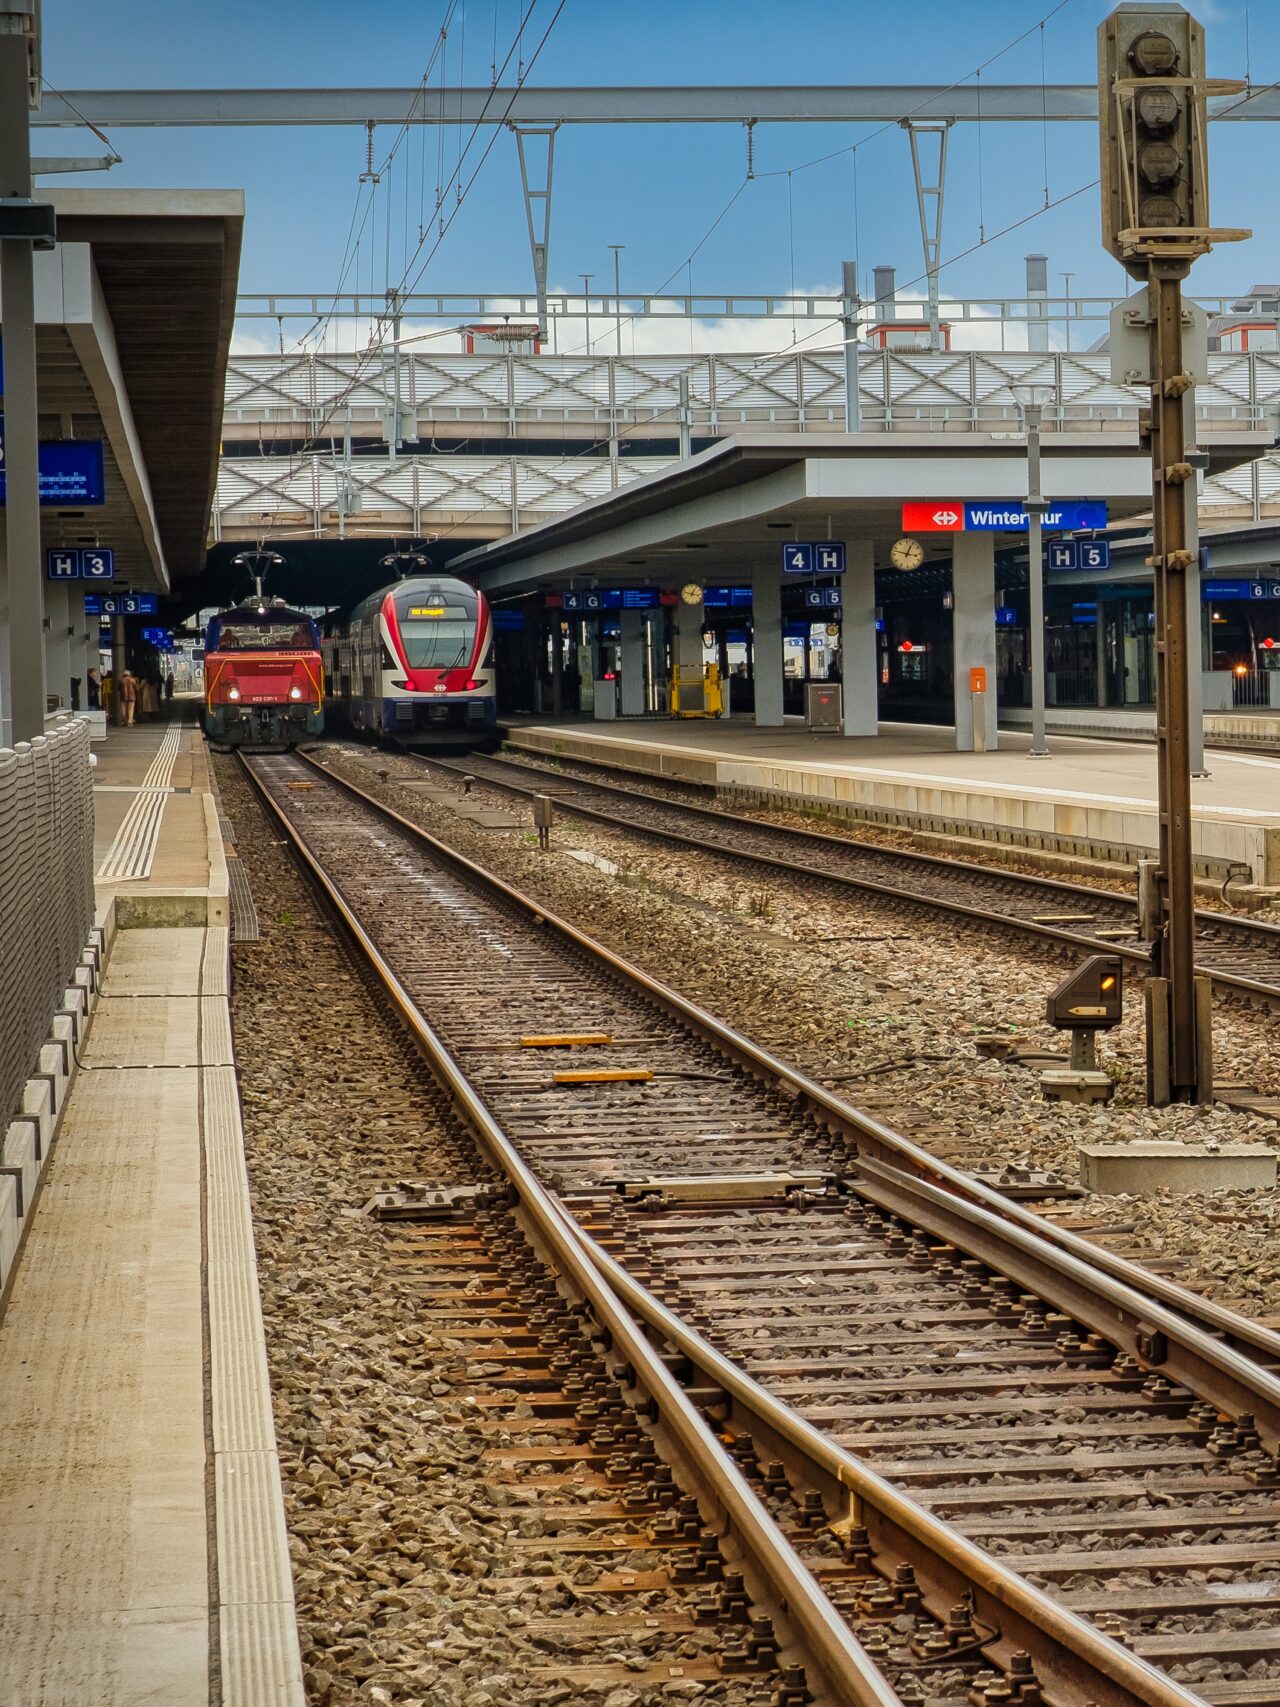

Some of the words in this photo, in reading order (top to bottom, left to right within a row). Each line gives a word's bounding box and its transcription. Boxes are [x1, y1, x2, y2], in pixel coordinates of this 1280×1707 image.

[970, 510, 1063, 526] Winterur
[791, 552, 805, 568] 4
[822, 552, 837, 568] H
[1056, 550, 1070, 566] H
[1088, 549, 1100, 566] 5
[56, 558, 72, 575] H
[91, 558, 104, 575] 3
[1254, 585, 1263, 596] 6
[568, 596, 577, 607] 4
[587, 596, 598, 607] G
[810, 593, 820, 604] G
[831, 593, 839, 603] 5
[104, 600, 115, 612] G
[126, 600, 136, 612] 3
[144, 631, 150, 639] E
